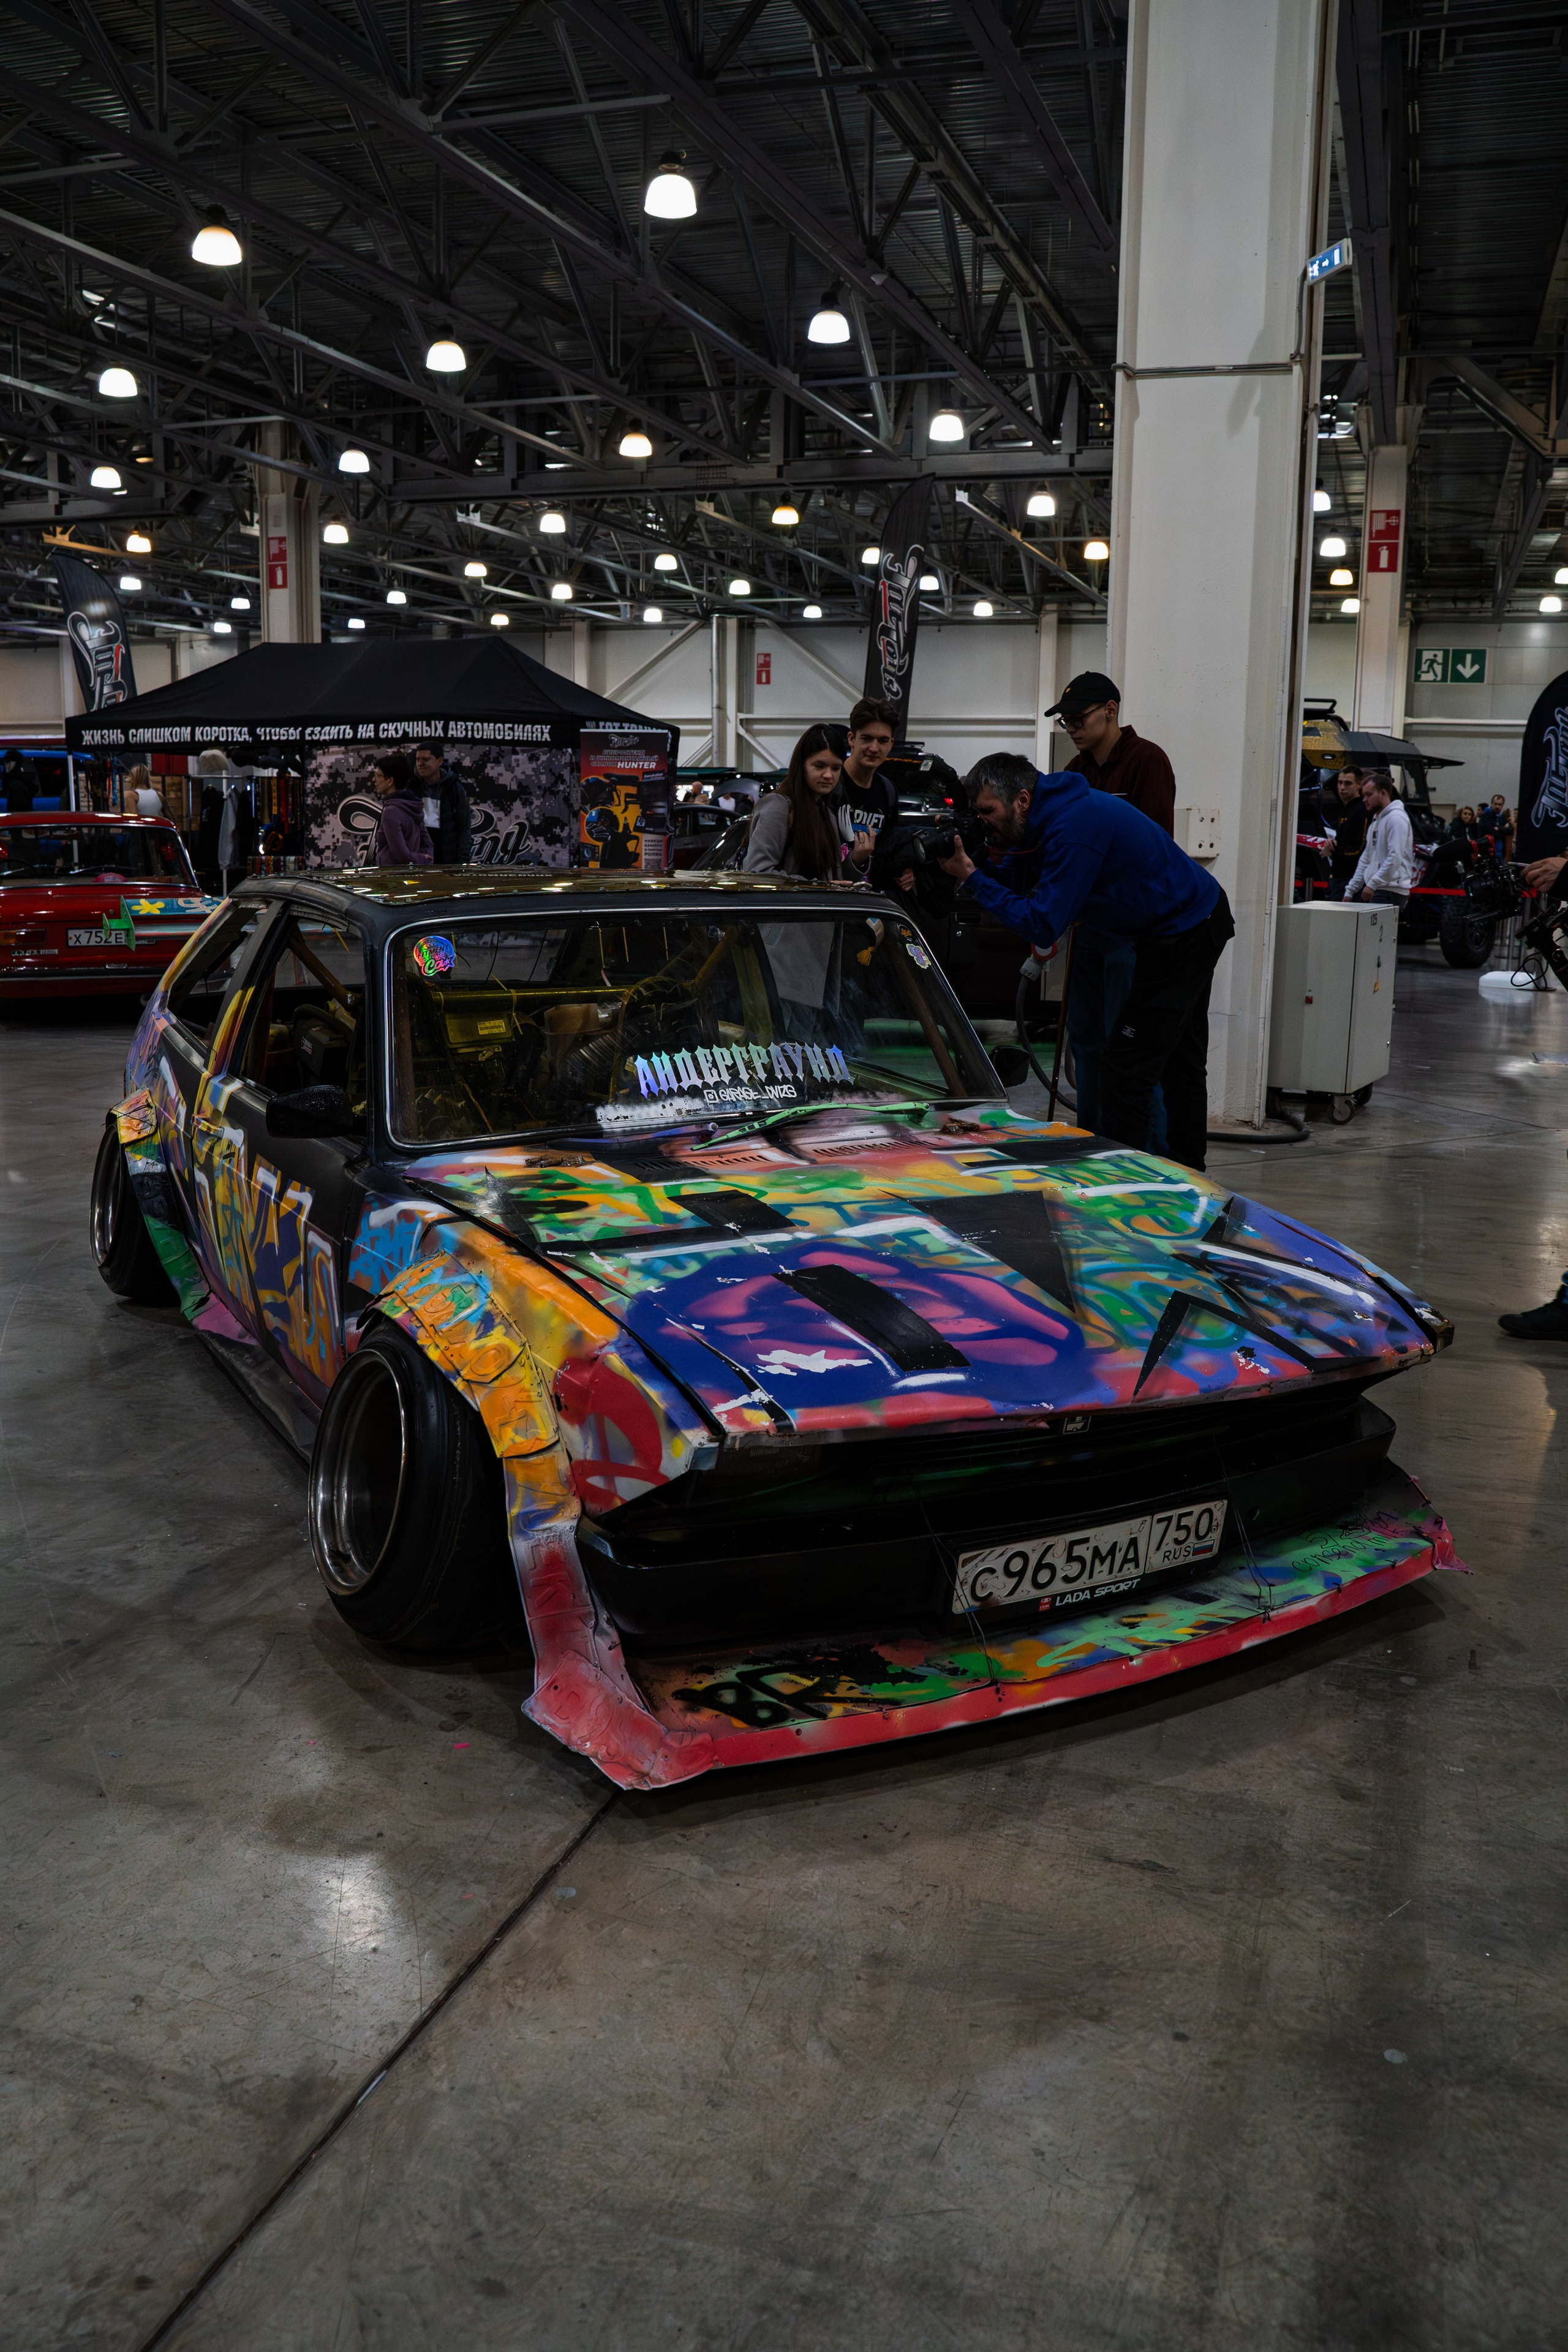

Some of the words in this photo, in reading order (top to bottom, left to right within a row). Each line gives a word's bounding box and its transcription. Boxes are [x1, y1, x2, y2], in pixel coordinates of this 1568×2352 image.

[81, 729, 125, 745] ЖИЗНЬ
[129, 726, 191, 744] СЛИШКОМ
[195, 726, 252, 743] КОРОТКА,
[304, 725, 353, 742] ЕЗДИТЬ
[357, 723, 375, 739] НА
[379, 720, 444, 739] СКУЧНЫХ
[448, 721, 551, 742] АВТОМОБИЛЯХ
[1155, 1508, 1214, 1551] 750
[1163, 1546, 1191, 1562] RUS
[1055, 1590, 1091, 1607] LADA
[1094, 1578, 1141, 1598] SPORT
